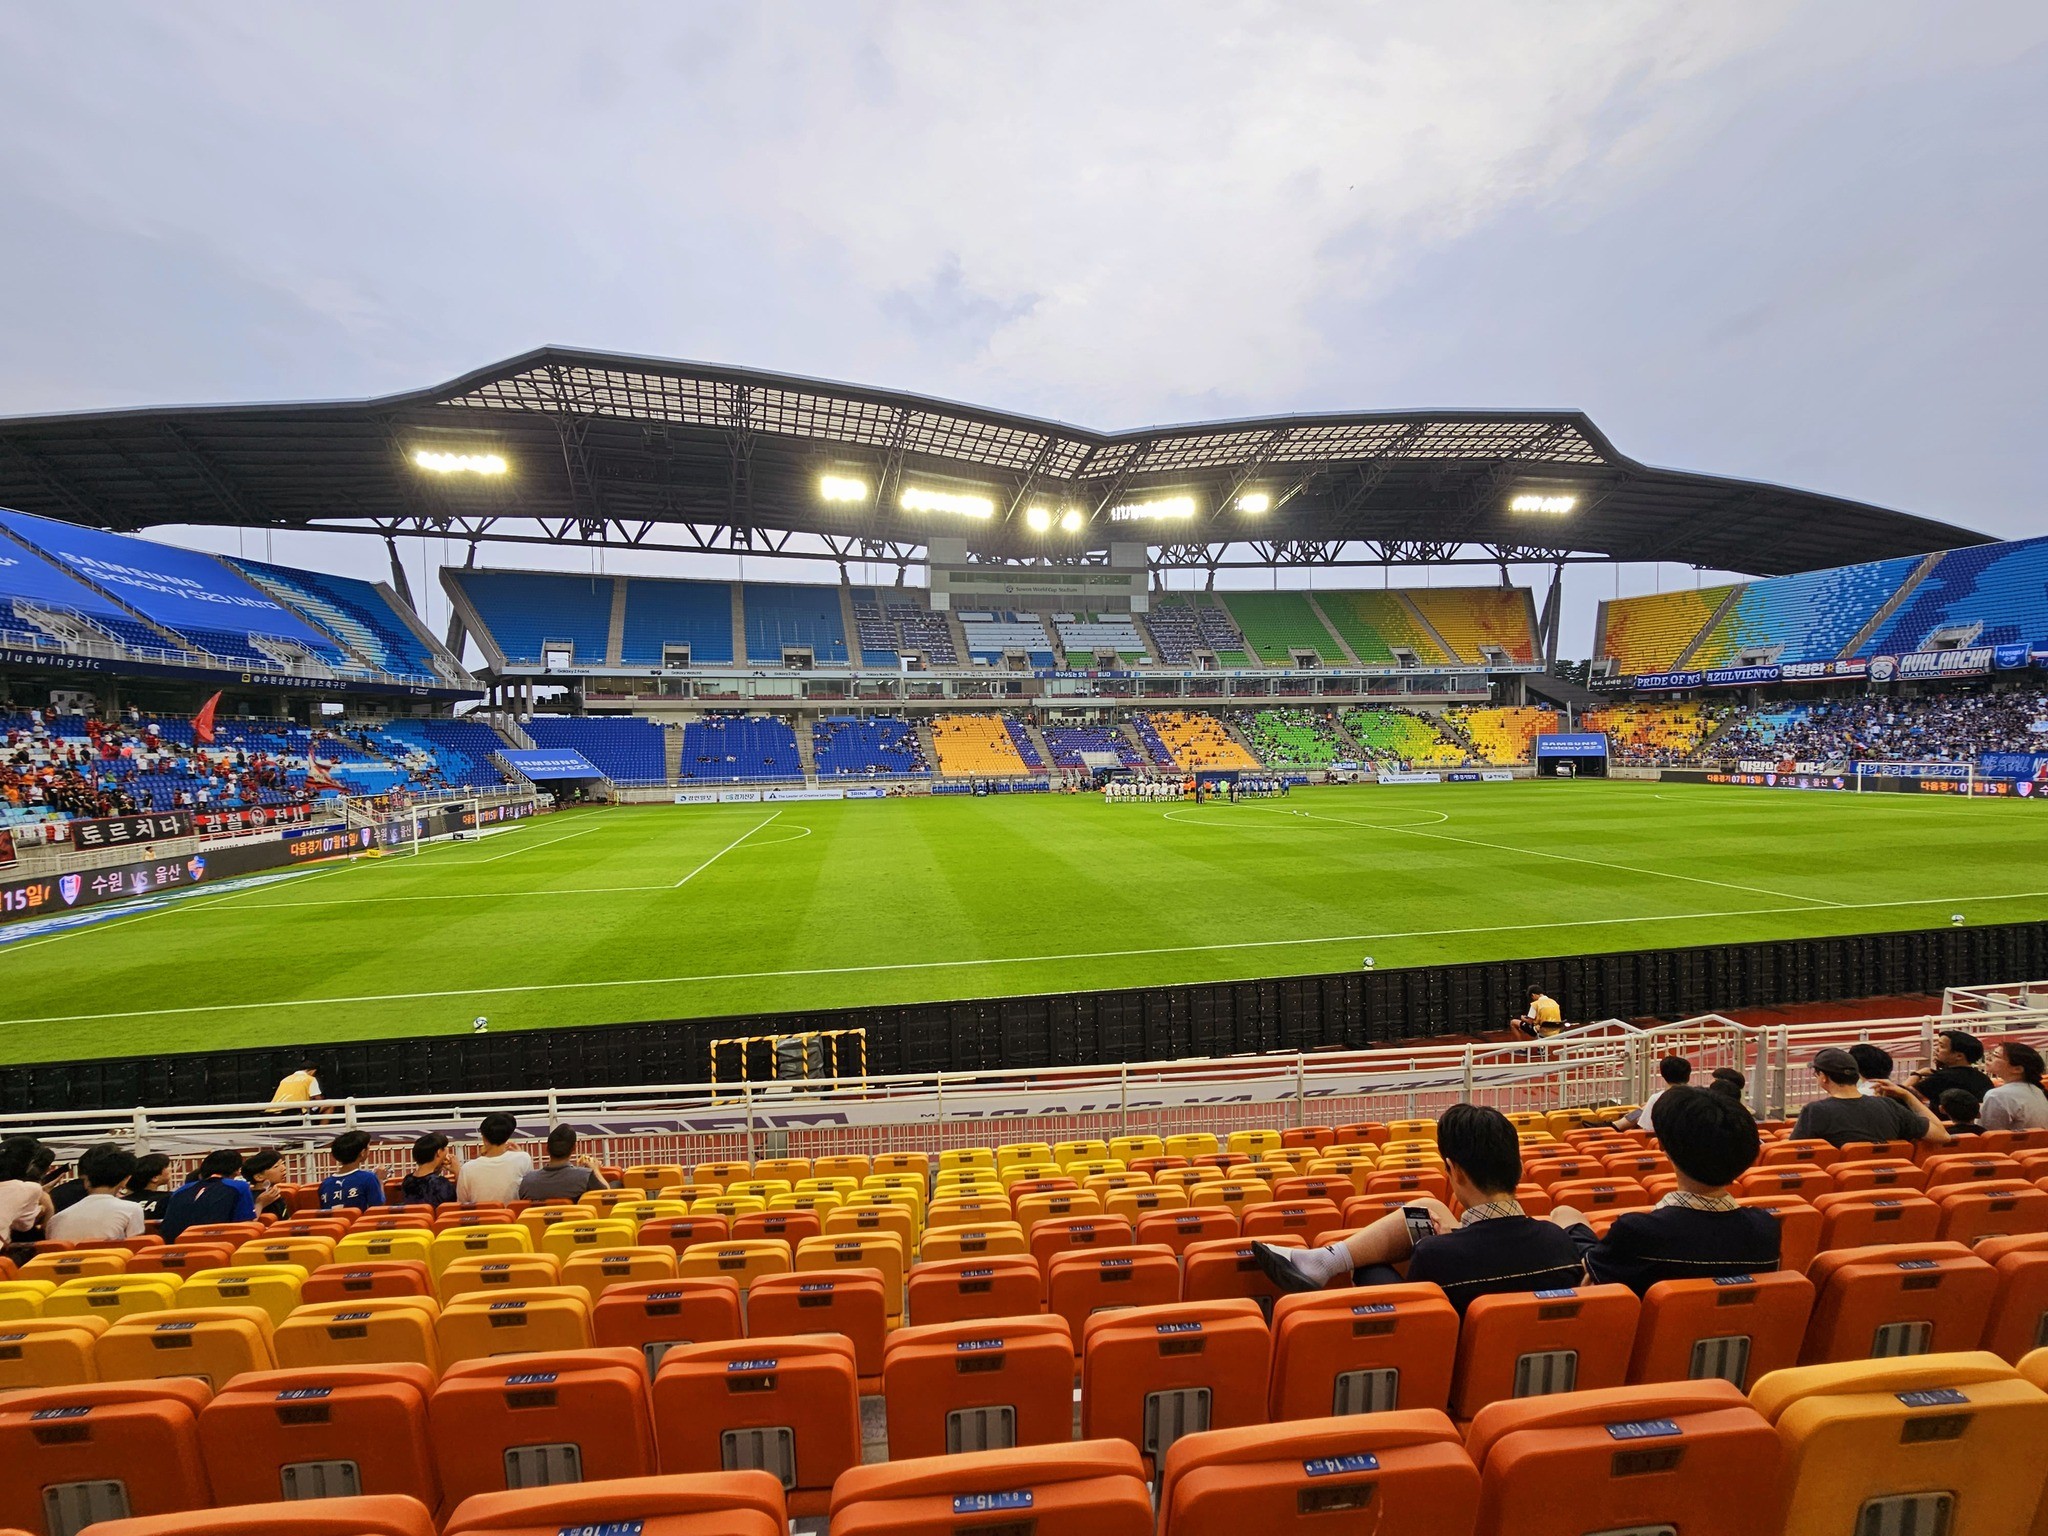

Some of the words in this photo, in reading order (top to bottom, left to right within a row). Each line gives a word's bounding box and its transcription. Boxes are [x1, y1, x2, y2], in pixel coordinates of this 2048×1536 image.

[58, 551, 203, 589] SAMSUNG
[83, 567, 188, 599] Galaxy
[227, 594, 283, 610] Ultra
[1900, 649, 1992, 671] AVALANCHA
[1637, 677, 1667, 687] PRIDE
[1670, 676, 1685, 684] OF
[1687, 674, 1700, 684] N3
[1706, 668, 1778, 682] AZULVIENTO
[1707, 775, 1731, 783] 다음경기
[1780, 776, 1796, 786] 수원
[1921, 782, 1958, 791] 다음경기
[290, 839, 322, 856] 다음경기
[92, 872, 122, 895] 수원
[131, 871, 148, 887] VS
[155, 864, 181, 884] 울산
[1170, 1324, 1181, 1332] 14
[1325, 1458, 1344, 1471] 14
[978, 1496, 995, 1508] 15
